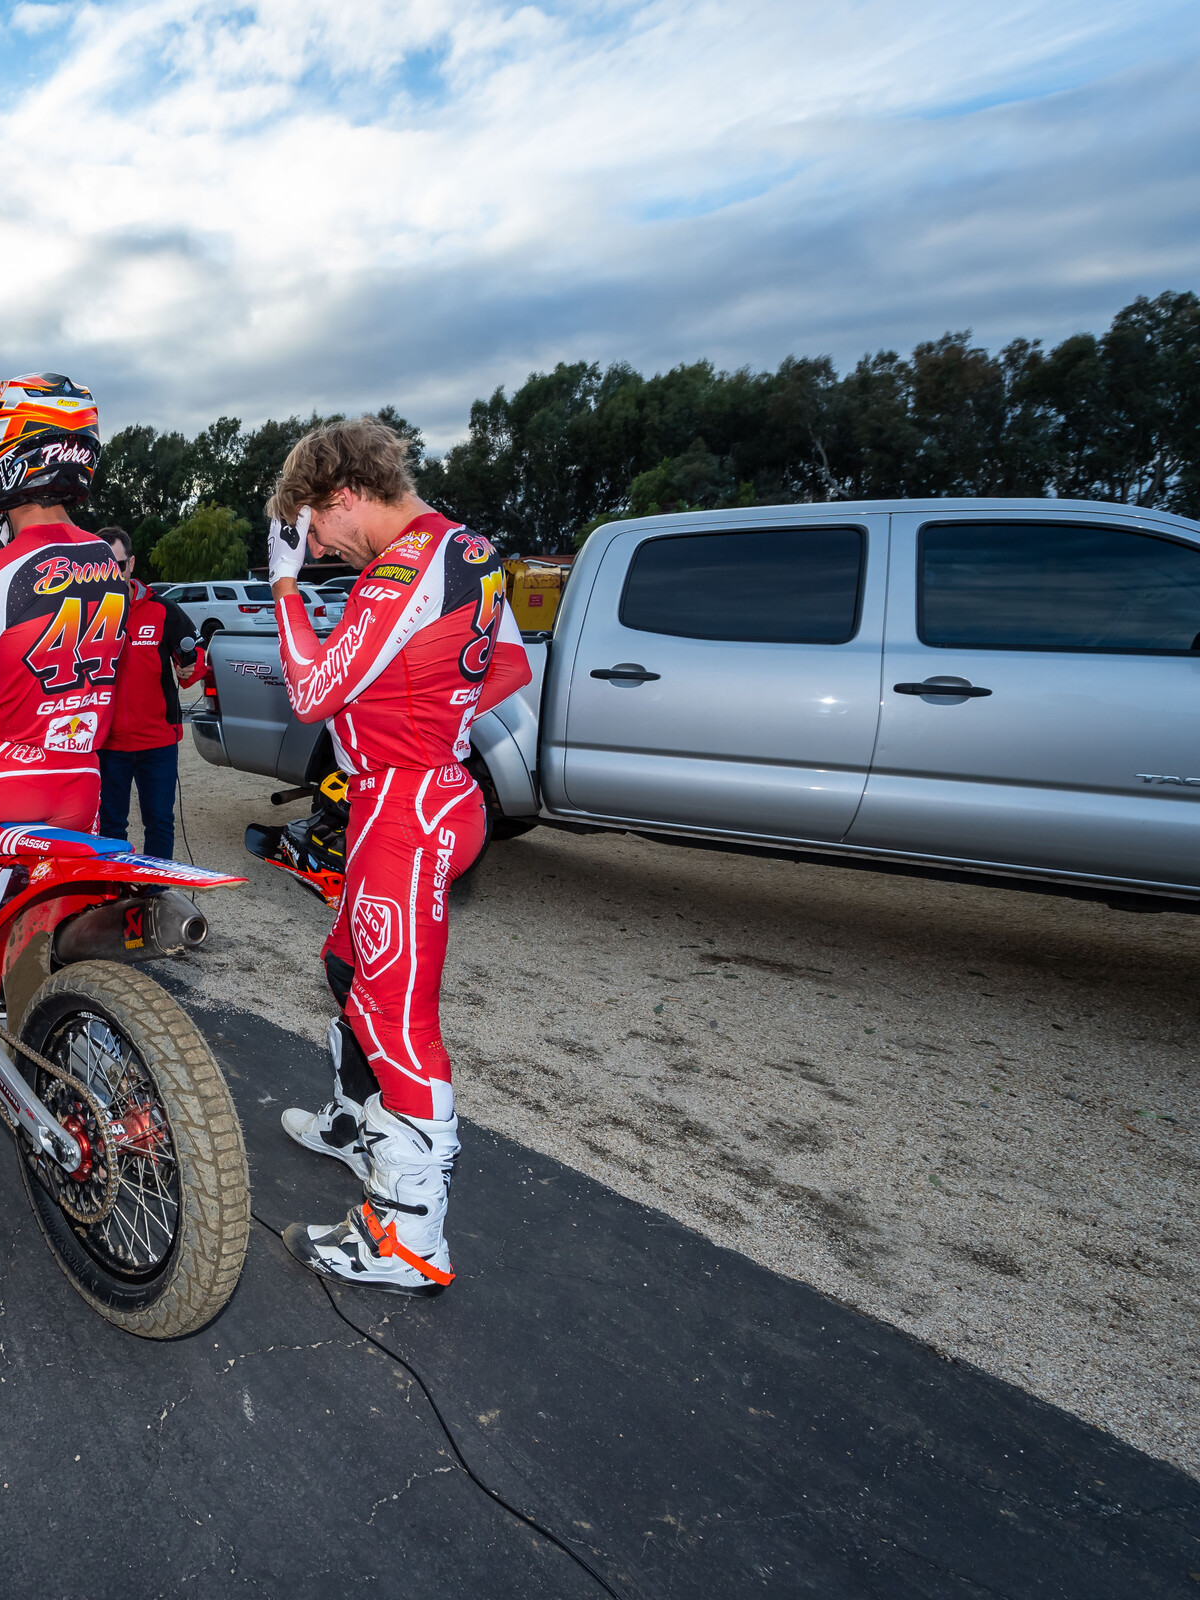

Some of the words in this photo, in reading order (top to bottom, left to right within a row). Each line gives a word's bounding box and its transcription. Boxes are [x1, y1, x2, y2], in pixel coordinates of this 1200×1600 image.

[42, 440, 92, 466] Pierce
[34, 556, 125, 595] Brown
[358, 585, 402, 601] WP
[396, 594, 430, 644] ULTRA
[26, 591, 126, 689] 44
[230, 662, 273, 677] TRD
[36, 692, 112, 715] GASGAS
[67, 737, 91, 751] Bull
[18, 837, 51, 851] GASGAS
[133, 867, 201, 882] DUNLOP
[432, 827, 456, 922] GASGAS
